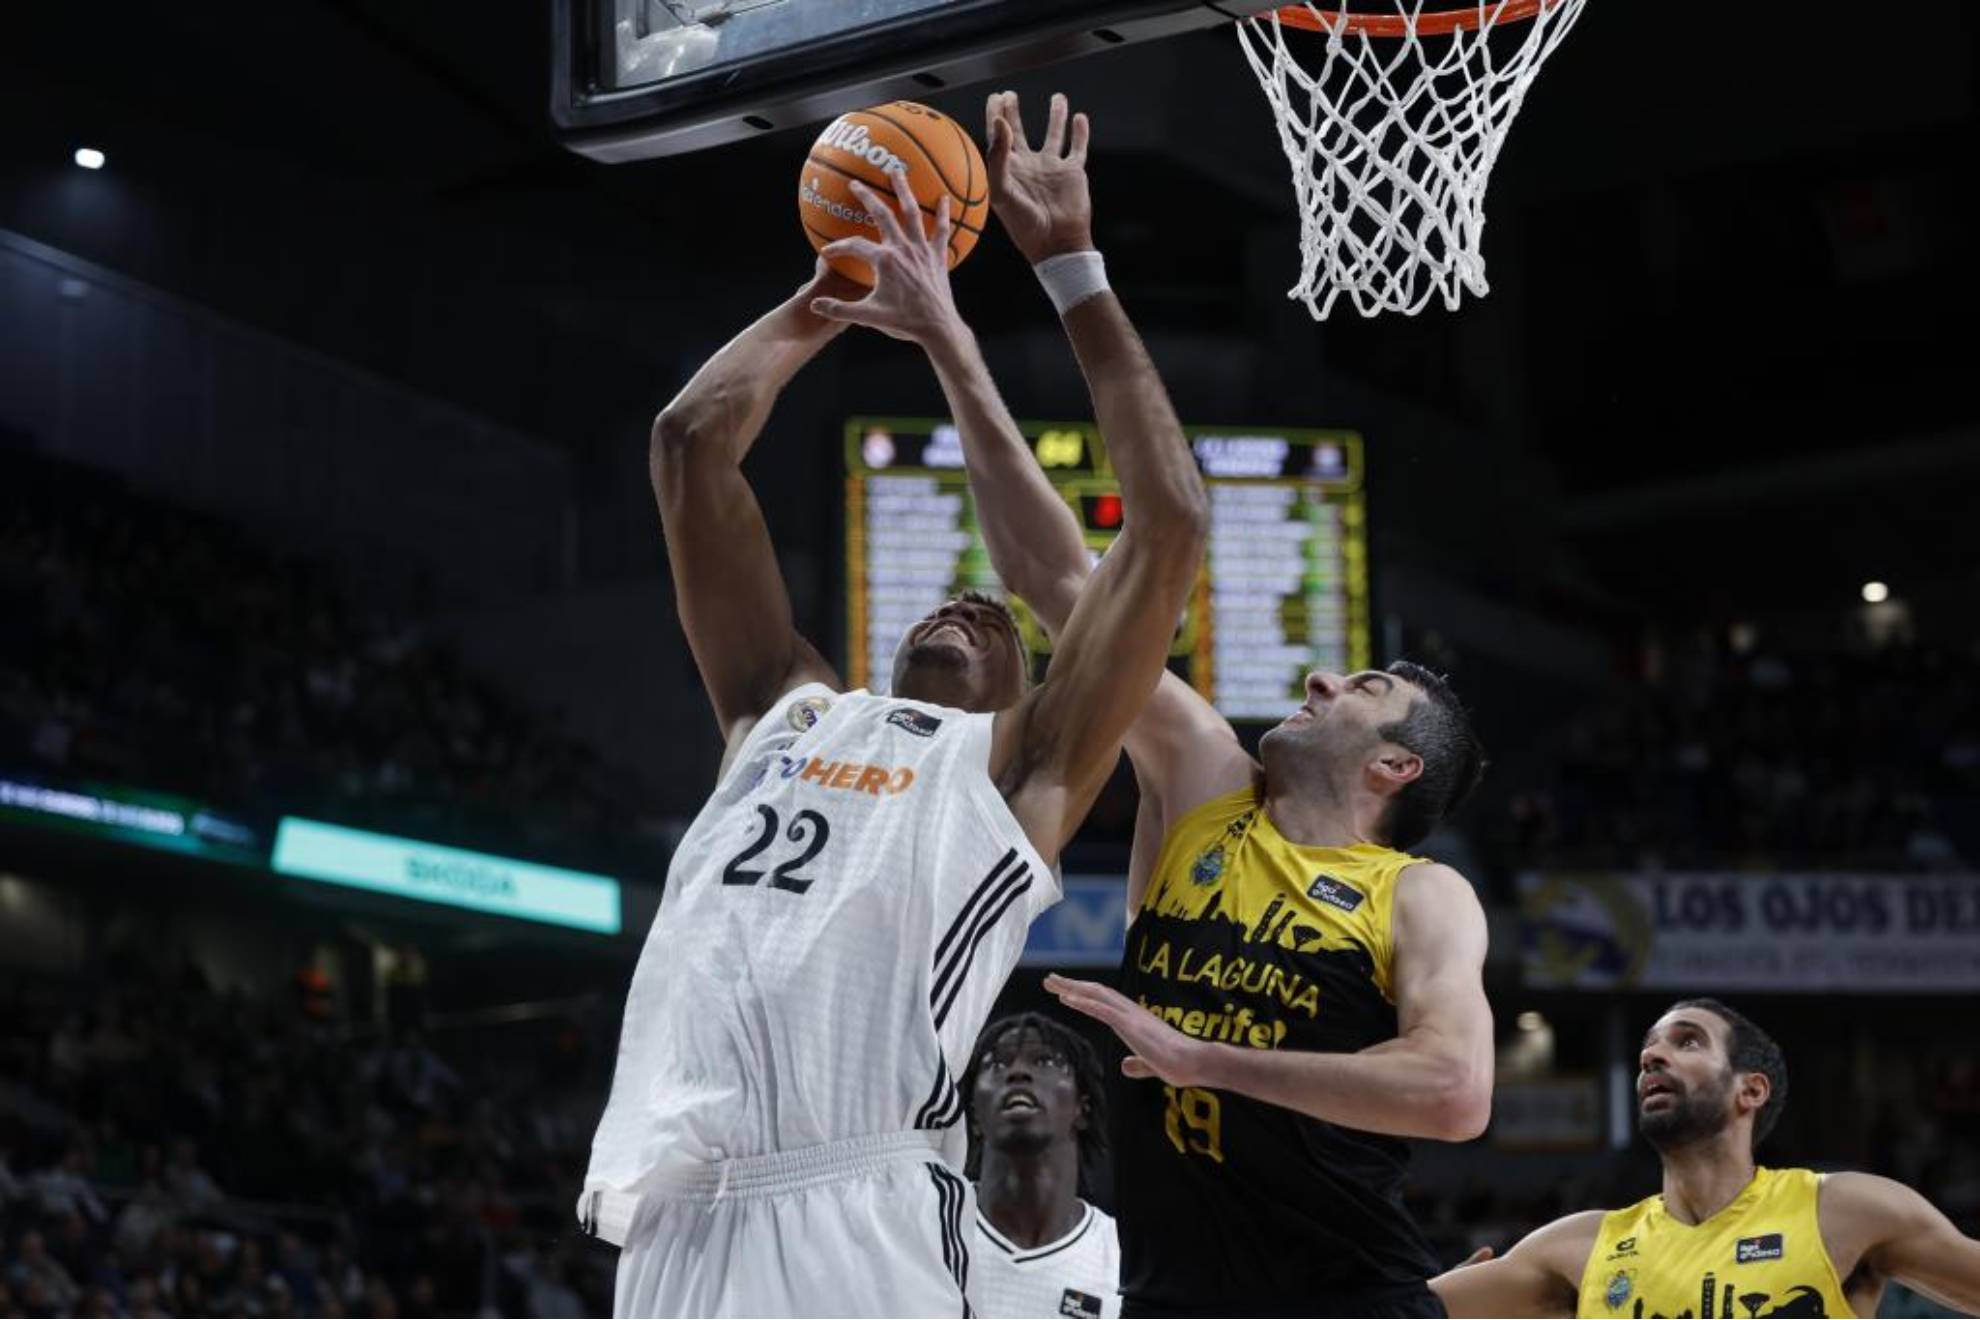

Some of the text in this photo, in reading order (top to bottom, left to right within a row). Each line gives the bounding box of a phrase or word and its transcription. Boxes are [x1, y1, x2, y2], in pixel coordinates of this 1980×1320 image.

[723, 804, 831, 895] 22
[1655, 882, 1744, 932] LOS
[1761, 882, 1889, 935] OJOS
[1138, 935, 1319, 1020] LA LAGUNA
